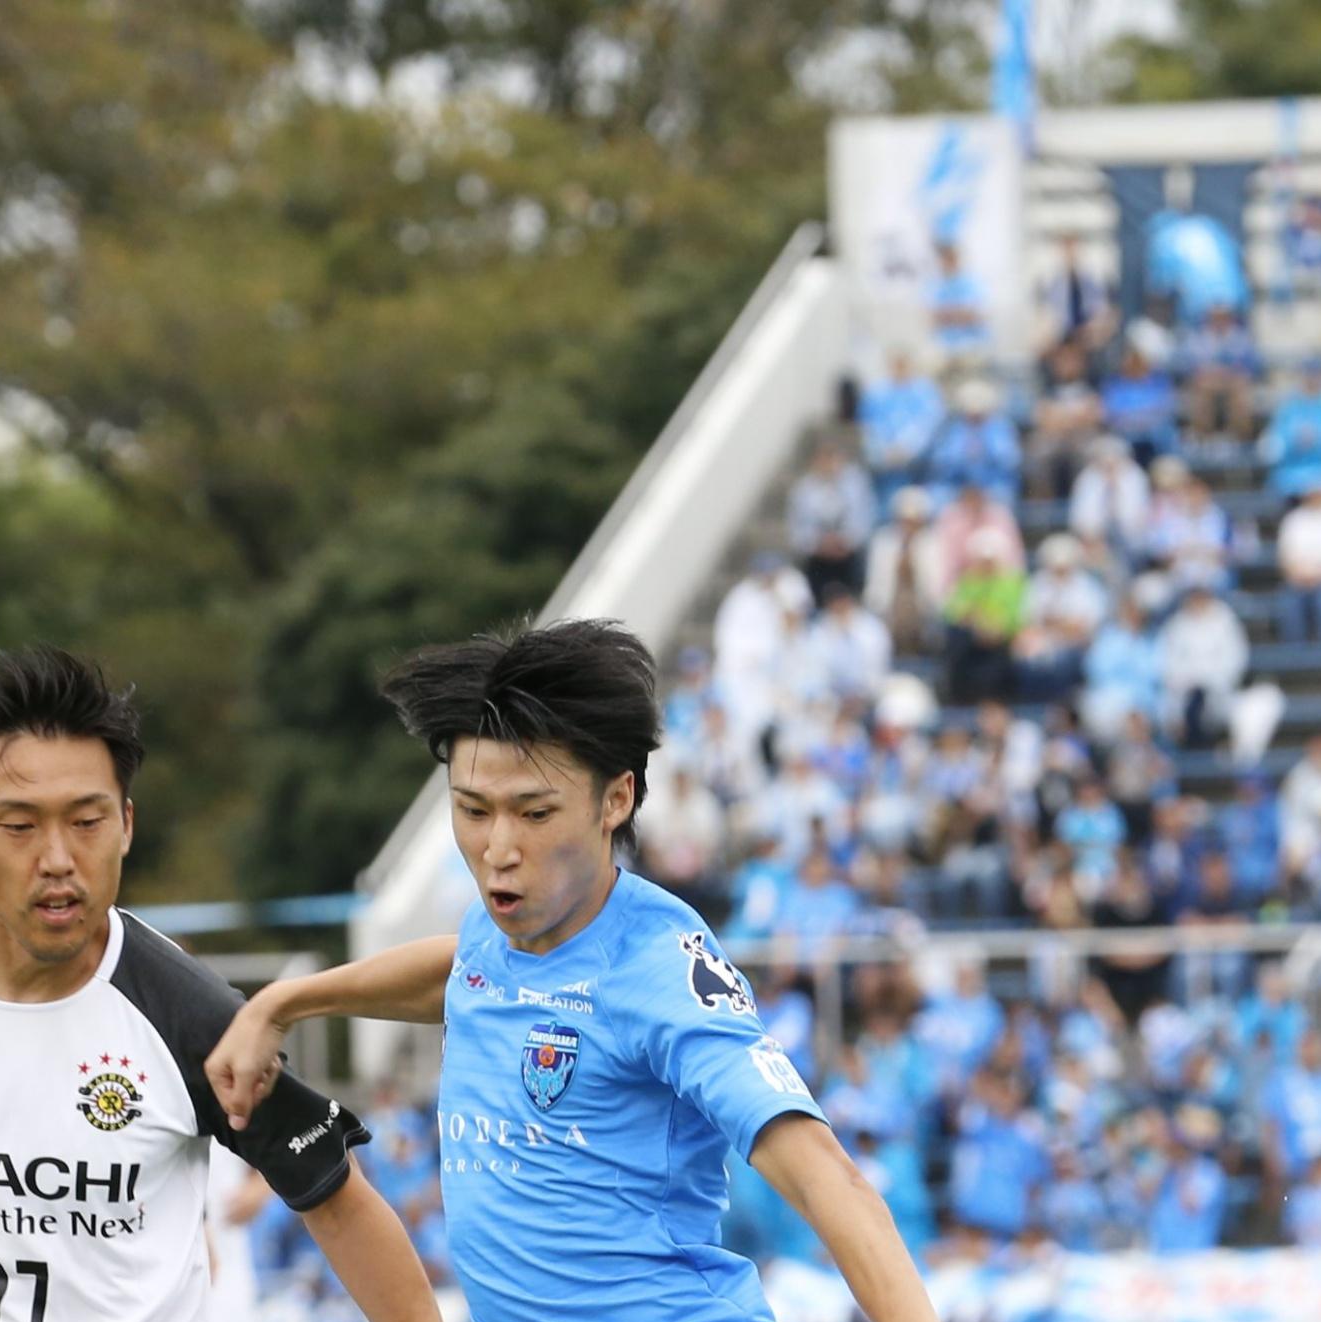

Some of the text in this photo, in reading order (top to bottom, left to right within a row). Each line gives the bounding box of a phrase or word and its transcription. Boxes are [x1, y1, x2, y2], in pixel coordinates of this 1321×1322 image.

[443, 1157, 521, 1175] GROUP
[0, 1207, 57, 1235] the
[68, 1202, 146, 1239] Next
